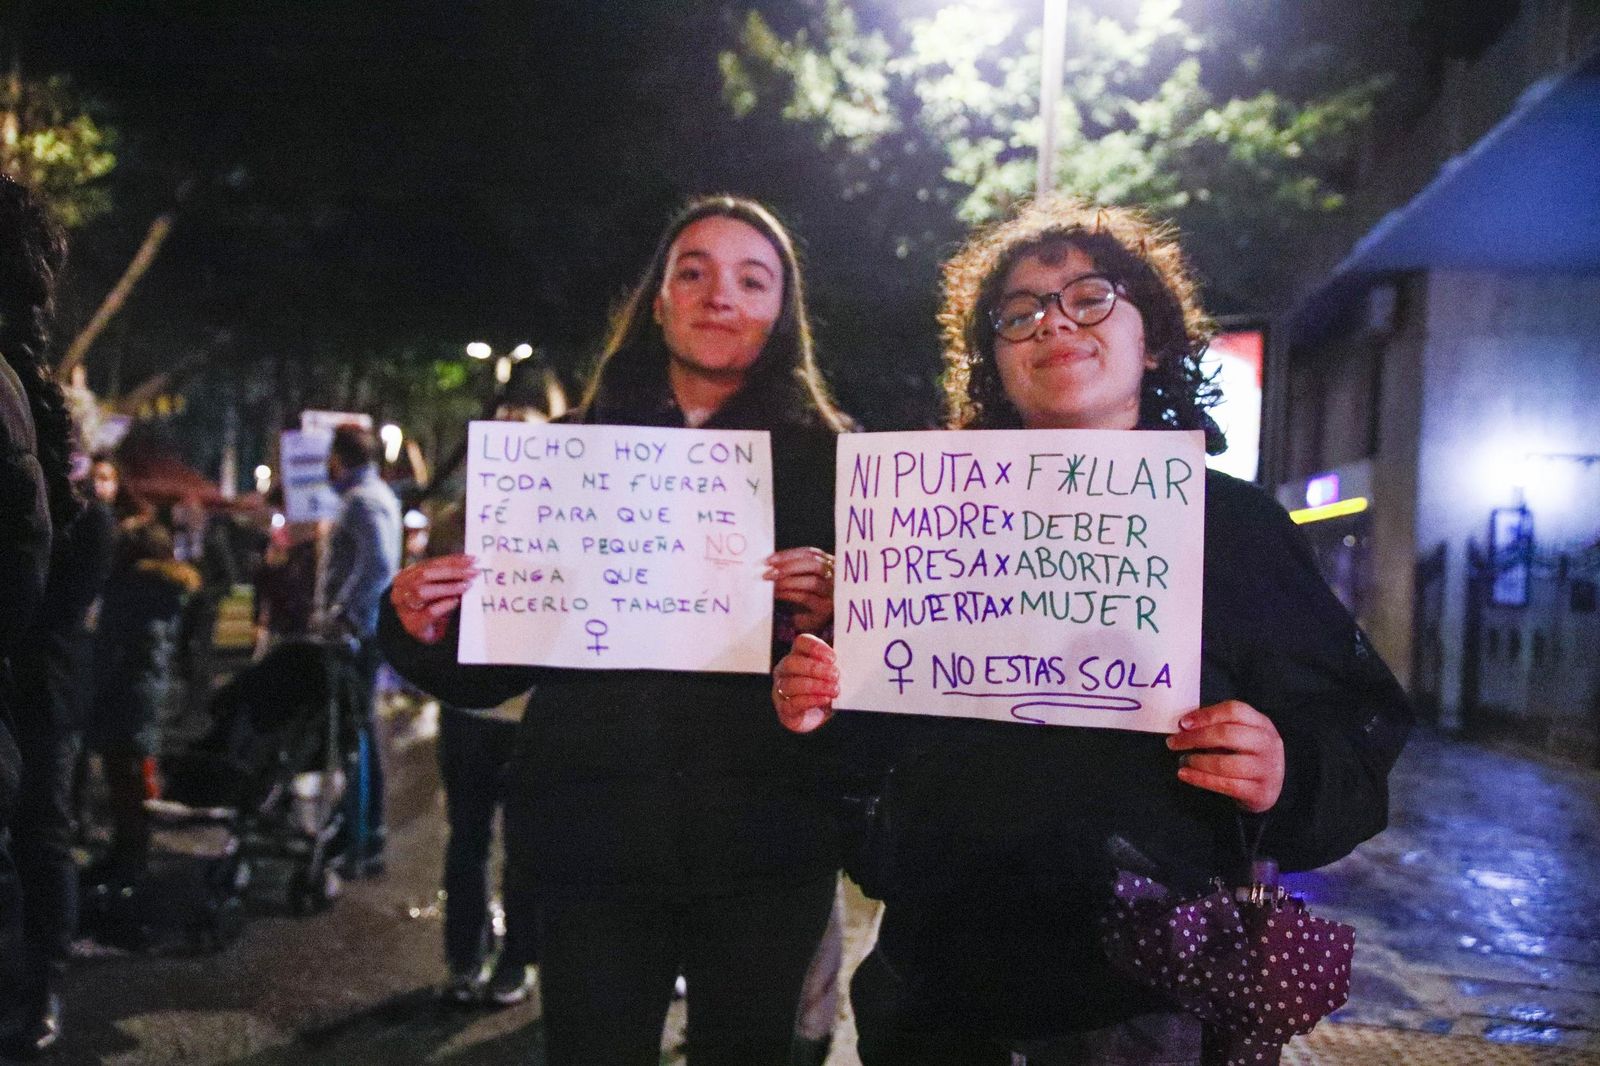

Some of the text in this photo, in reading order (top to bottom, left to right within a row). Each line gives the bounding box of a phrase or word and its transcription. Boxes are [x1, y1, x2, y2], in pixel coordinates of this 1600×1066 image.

[483, 434, 753, 464] LUCHO HOY CON
[479, 473, 552, 491] TODA
[629, 474, 727, 493] FUERZA
[747, 479, 760, 495] Y
[850, 453, 880, 498] NI
[894, 452, 986, 497] PUTA
[538, 507, 597, 523] PARA
[617, 507, 671, 523] QUE
[698, 511, 736, 525] MI
[847, 506, 873, 543] NI
[889, 502, 999, 540] MADRE
[1022, 511, 1148, 548] DEBER
[482, 533, 747, 555] PRIMA PEQUEÑA NO
[480, 569, 648, 585] TENGA QUE
[844, 550, 868, 583] NI
[880, 546, 988, 584] PRESA
[1014, 547, 1169, 589] ABORTAR
[481, 590, 730, 614] HACERLO TAMBIÉN
[847, 599, 873, 633] NI
[884, 592, 1000, 628] MUERTA
[1020, 591, 1160, 633] MUJER
[932, 653, 1172, 691] NO ESTAS SOLA
